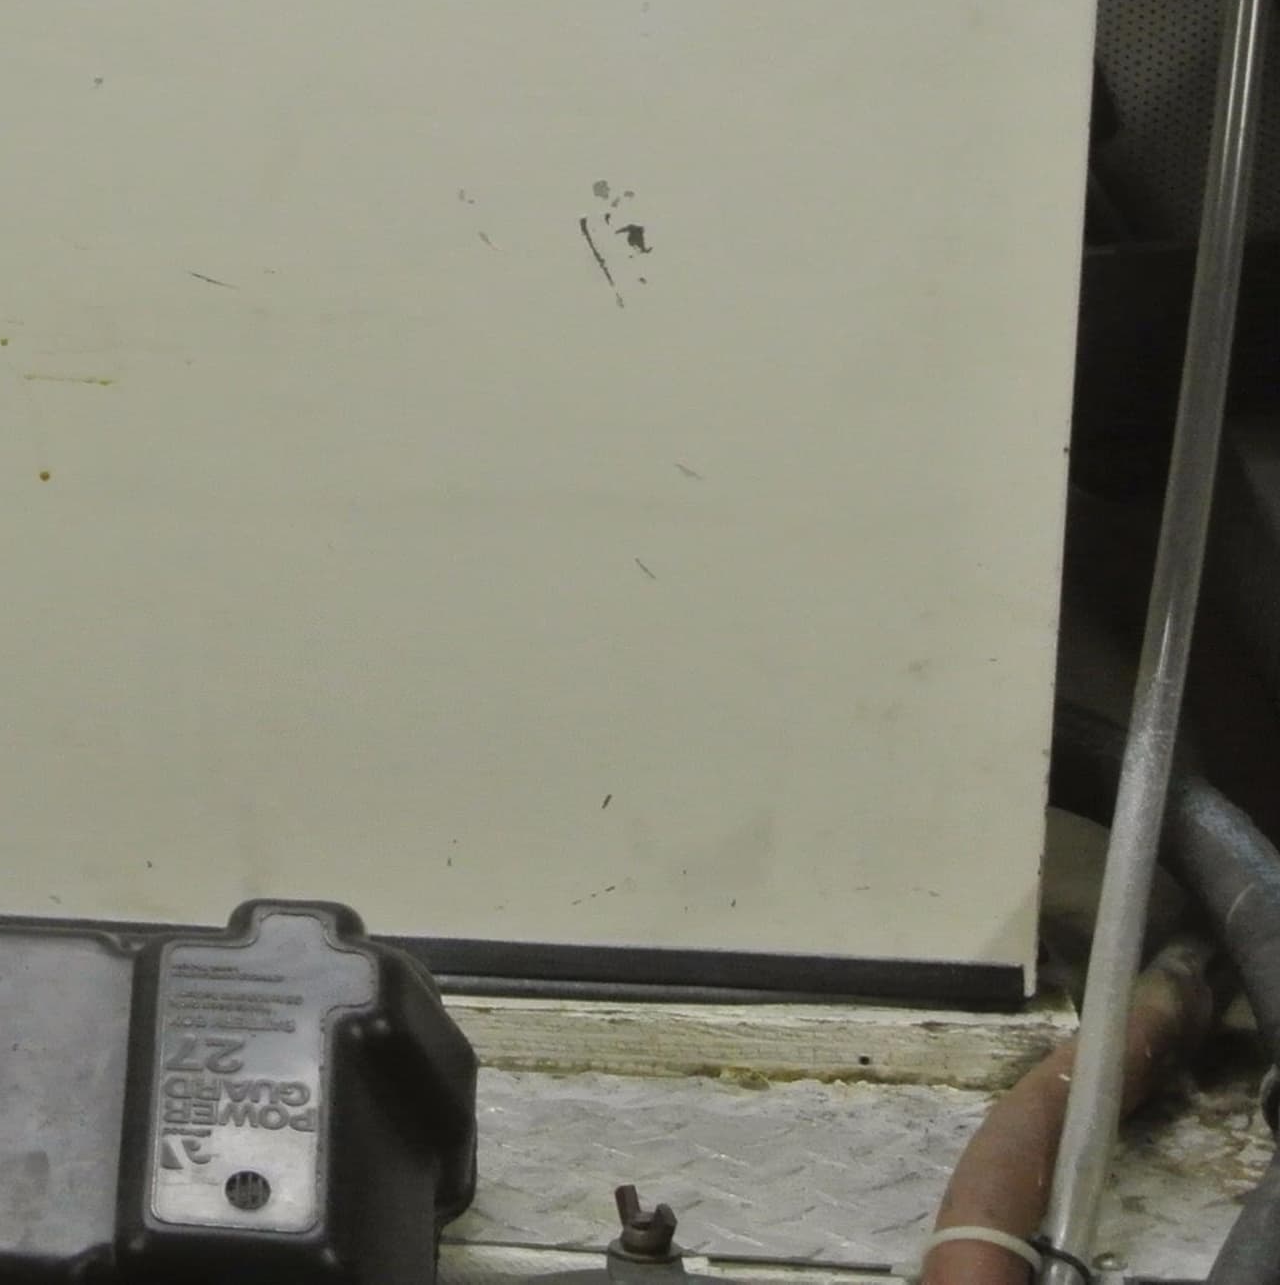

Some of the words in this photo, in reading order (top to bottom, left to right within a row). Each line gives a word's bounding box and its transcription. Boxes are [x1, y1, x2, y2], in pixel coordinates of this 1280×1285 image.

[162, 1033, 248, 1075] 27
[161, 1076, 312, 1108] GUARD
[162, 1100, 318, 1132] POWER
